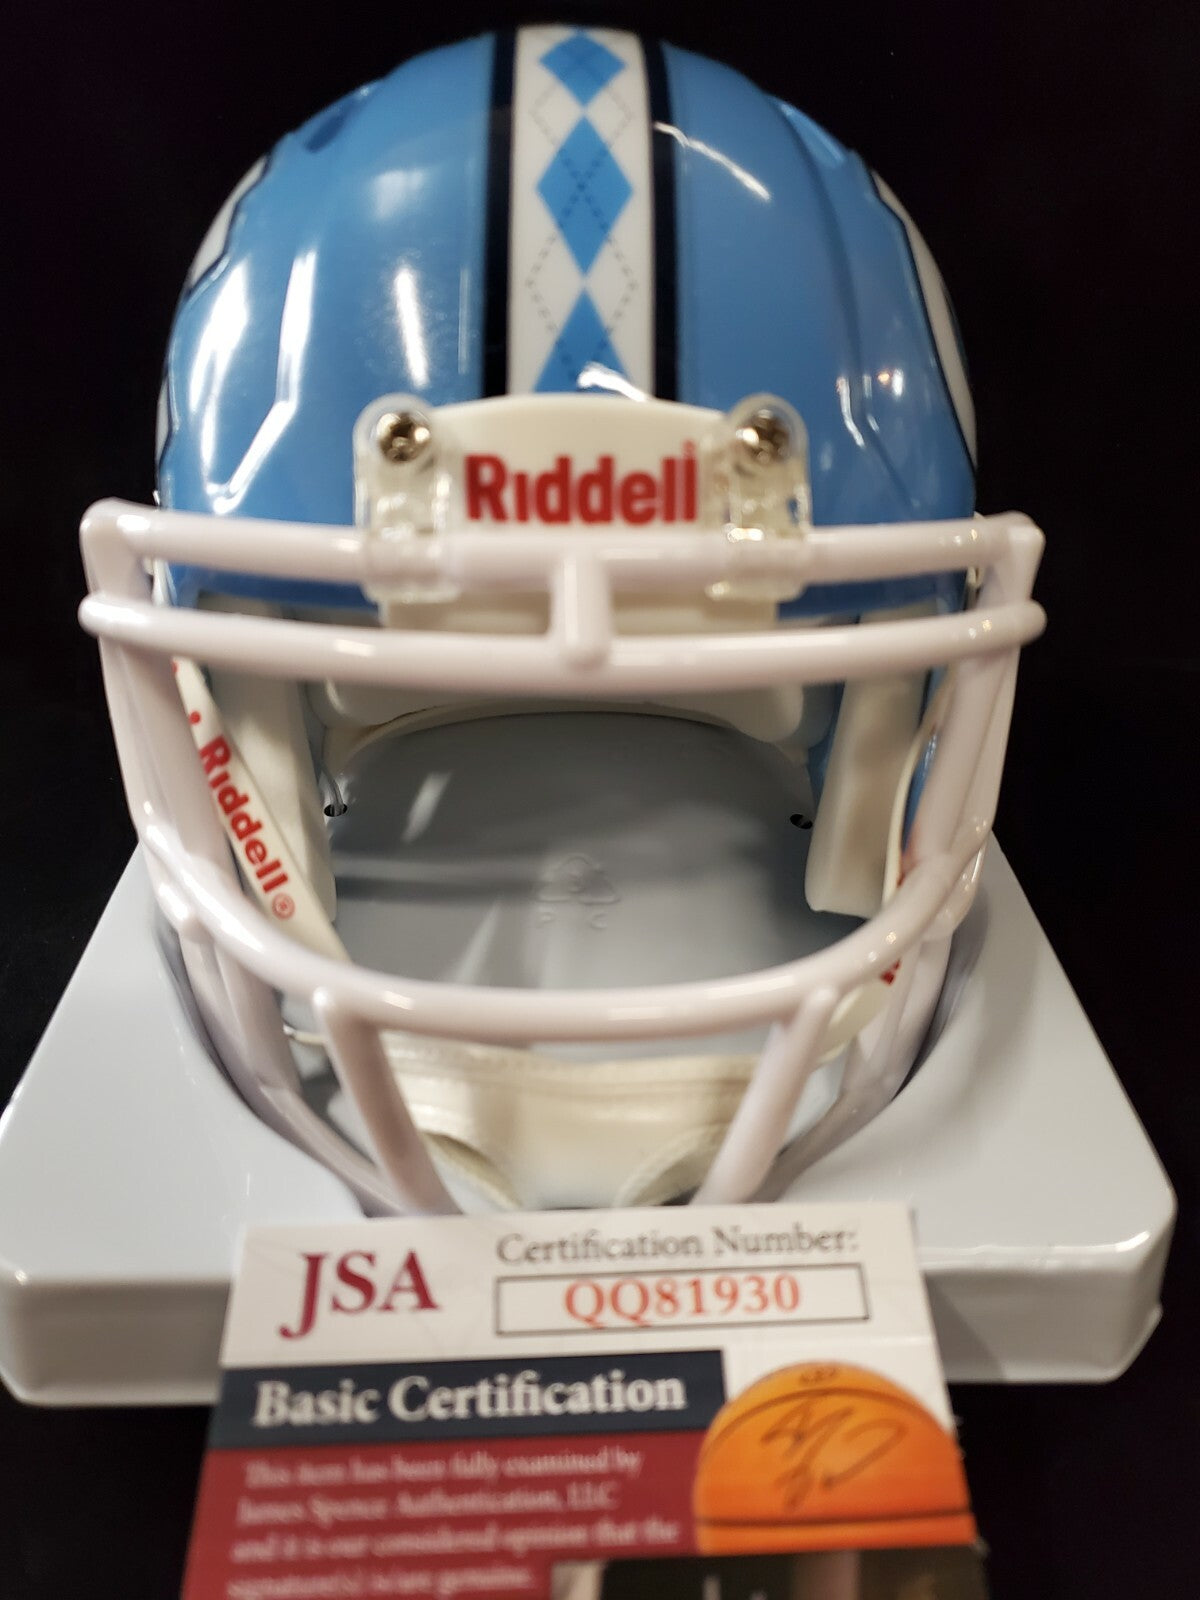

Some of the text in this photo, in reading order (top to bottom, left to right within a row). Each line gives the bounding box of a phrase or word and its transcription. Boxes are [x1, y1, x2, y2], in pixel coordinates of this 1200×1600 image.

[498, 1222, 859, 1265] Certification Number:
[278, 1249, 438, 1341] JSA
[564, 1273, 801, 1329] QQ81930
[253, 1368, 688, 1428] Basic Certification
